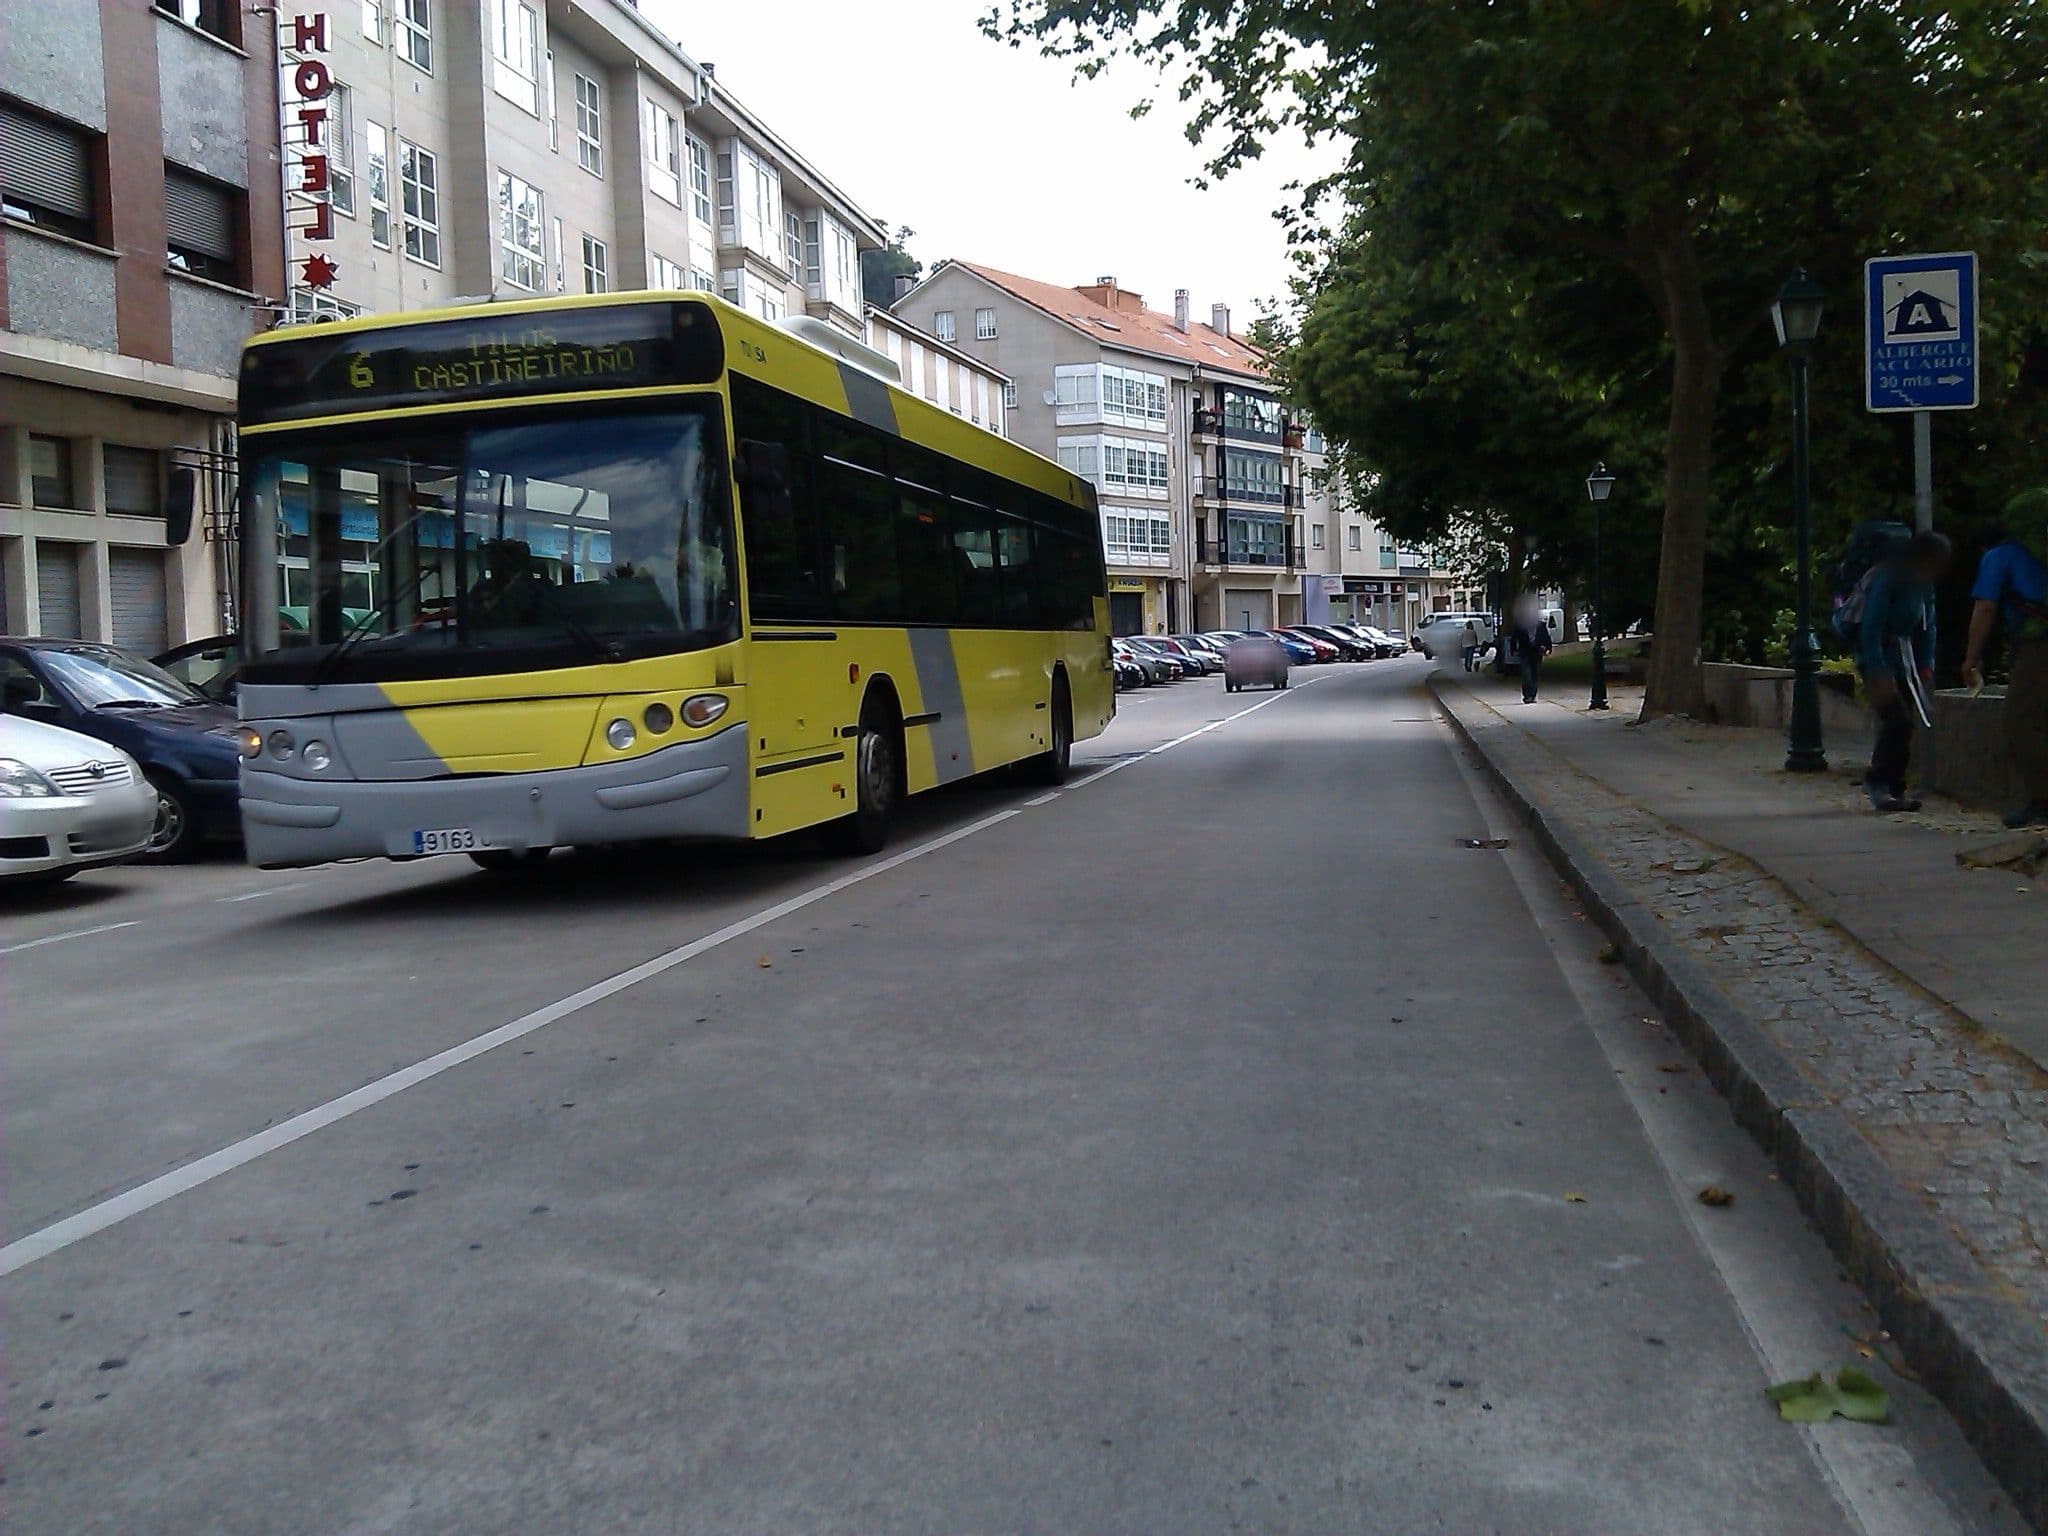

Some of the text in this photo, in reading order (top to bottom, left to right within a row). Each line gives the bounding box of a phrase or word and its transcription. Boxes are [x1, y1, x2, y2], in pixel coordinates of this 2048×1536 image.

[1907, 303, 1932, 325] A
[351, 351, 374, 388] 6
[1880, 376, 1898, 388] 30
[426, 830, 475, 850] 9163
